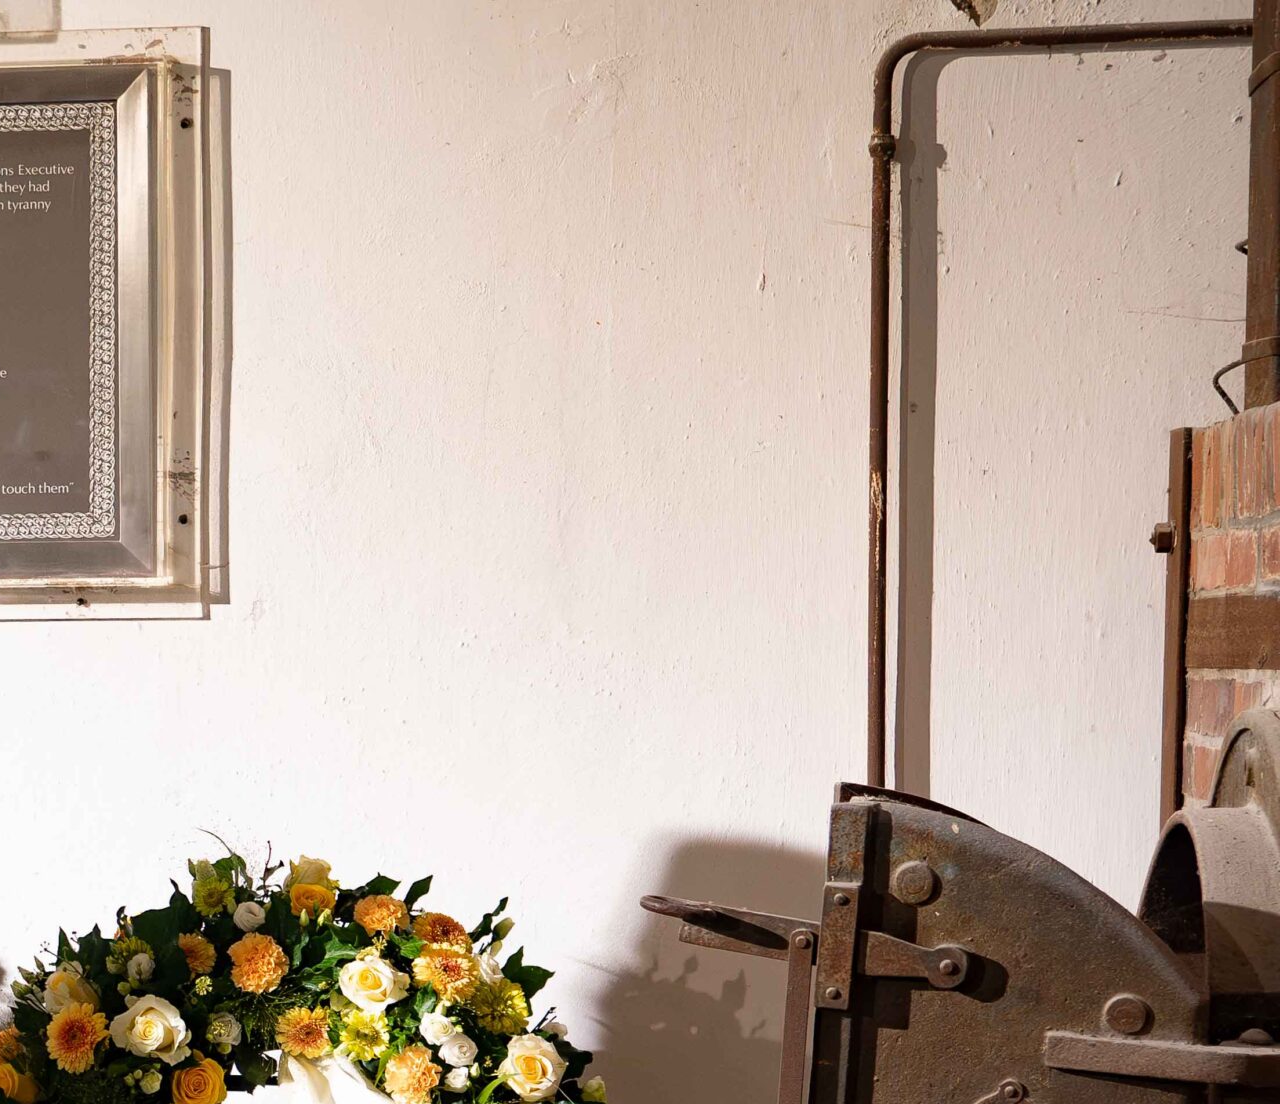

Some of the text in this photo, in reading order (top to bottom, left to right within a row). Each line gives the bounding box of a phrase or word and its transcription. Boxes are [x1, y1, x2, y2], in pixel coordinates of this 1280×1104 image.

[18, 163, 74, 178] Executive
[0, 181, 26, 196] they
[28, 180, 50, 192] had
[7, 200, 52, 214] tyranny
[1, 482, 36, 495] touch
